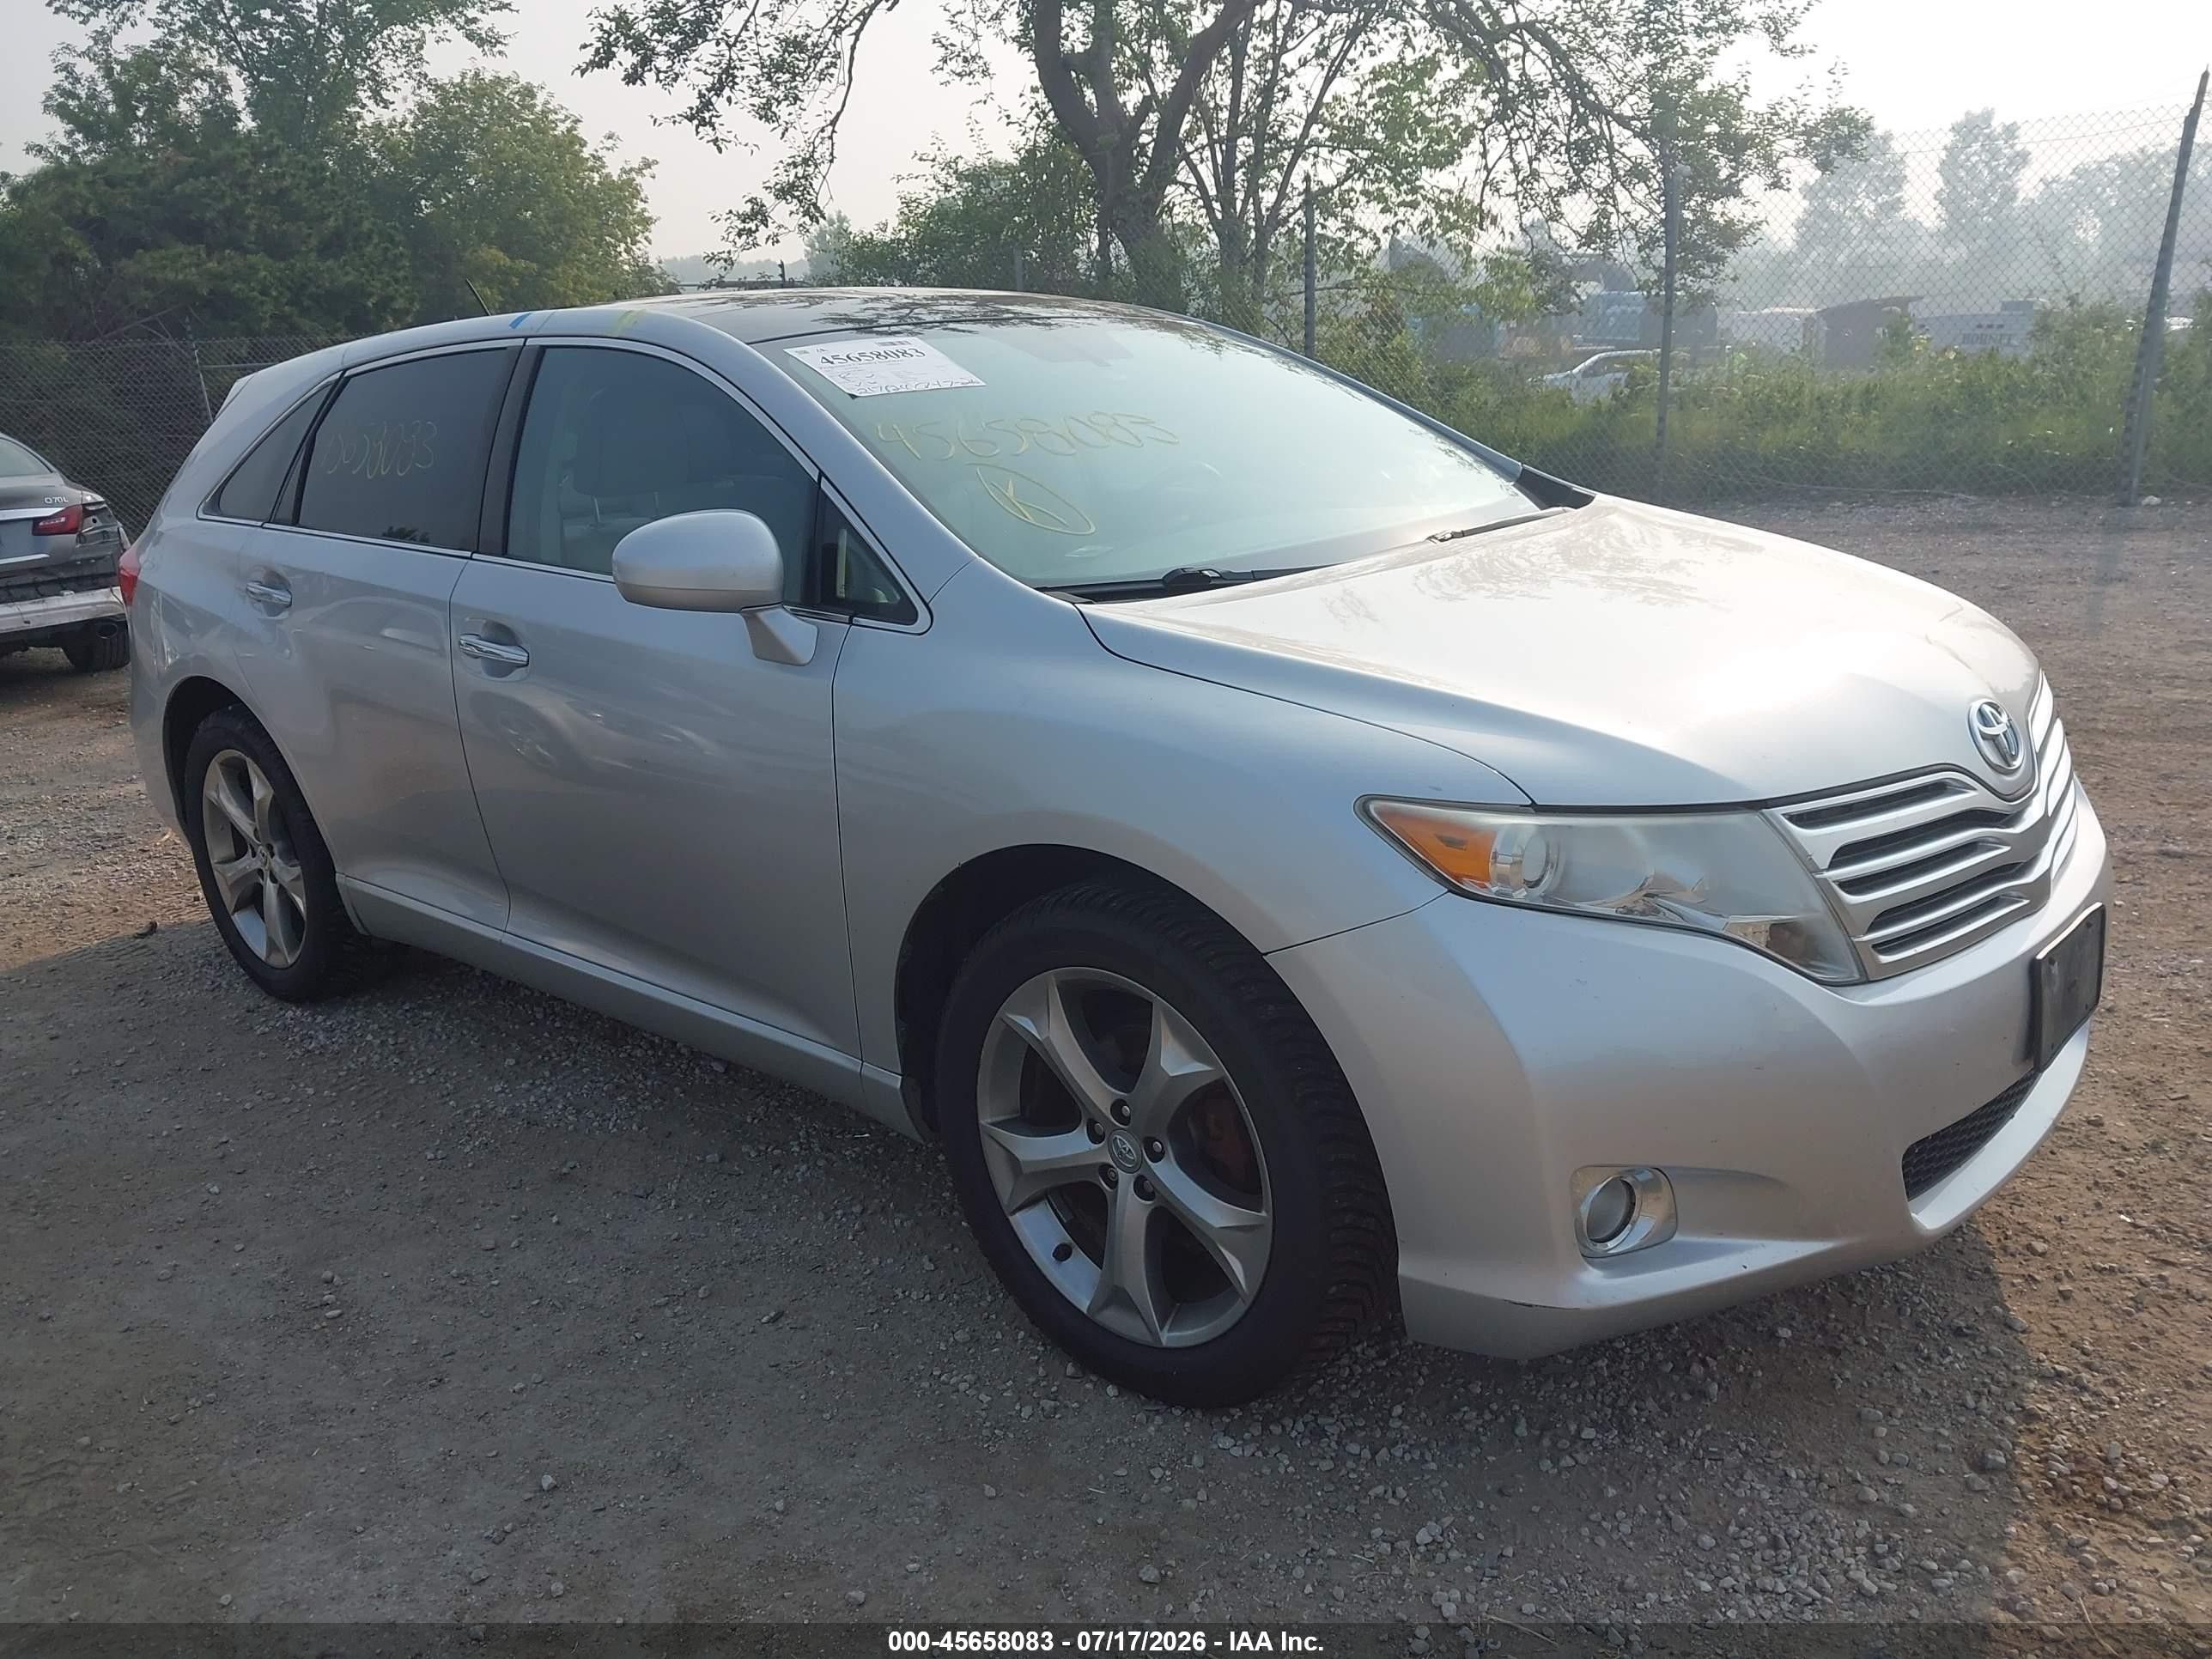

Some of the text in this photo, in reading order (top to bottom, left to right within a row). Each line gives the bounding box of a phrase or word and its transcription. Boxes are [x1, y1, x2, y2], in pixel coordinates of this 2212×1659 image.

[1963, 332, 2013, 344] HORNET
[819, 347, 927, 365] 45658083
[876, 410, 1180, 461] 45658083
